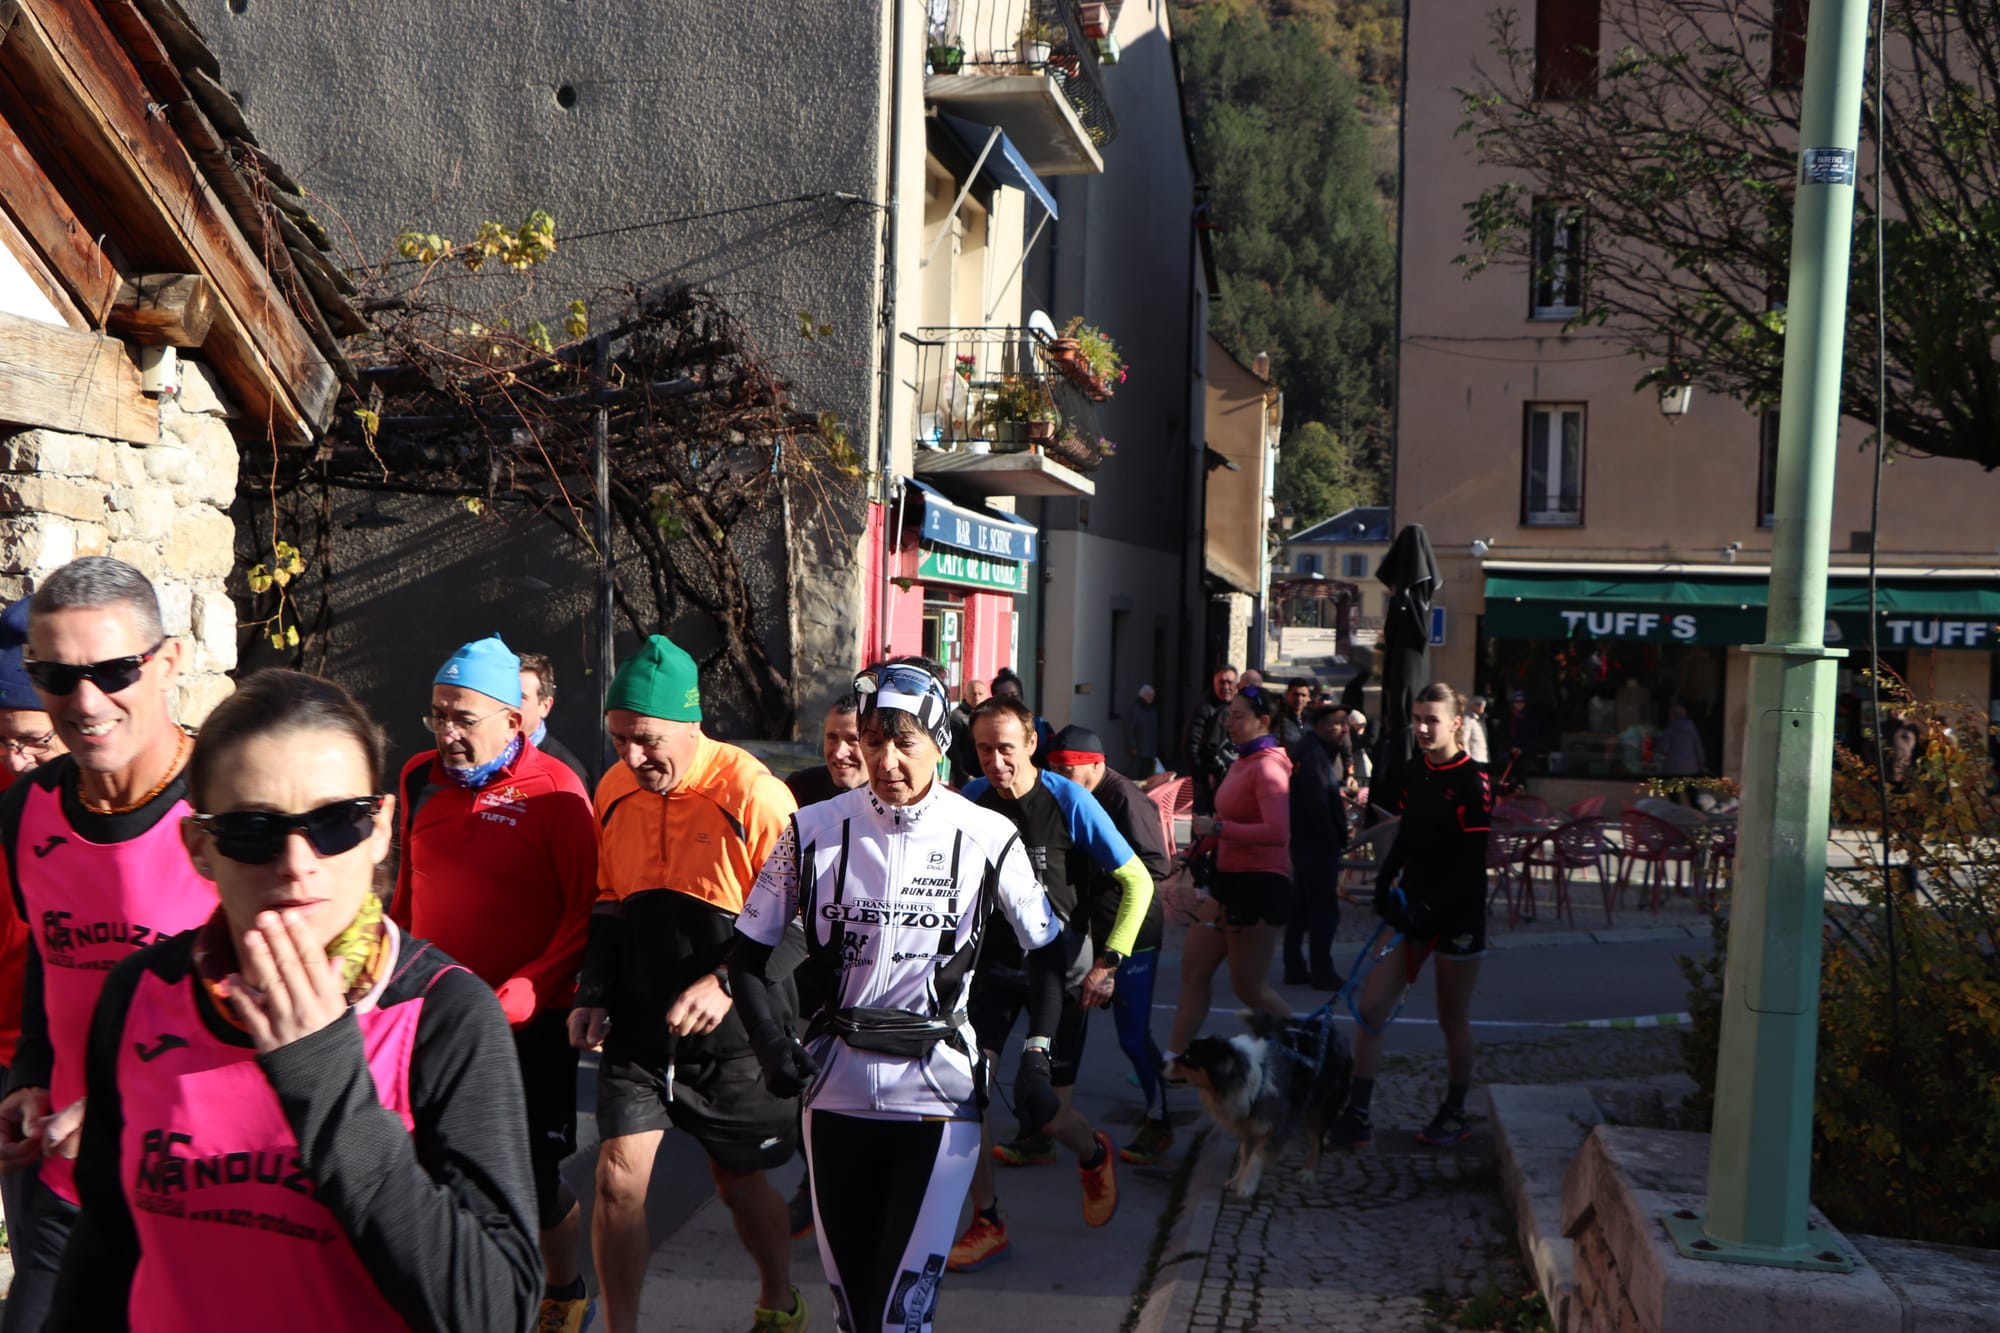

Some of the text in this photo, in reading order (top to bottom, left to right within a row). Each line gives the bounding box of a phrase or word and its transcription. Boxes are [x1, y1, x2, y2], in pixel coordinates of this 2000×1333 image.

[956, 517, 971, 546] BAR
[978, 525, 988, 551] LE
[1560, 611, 1697, 639] TUFF'S
[911, 877, 952, 887] MENDE
[821, 904, 961, 928] GLEYZON
